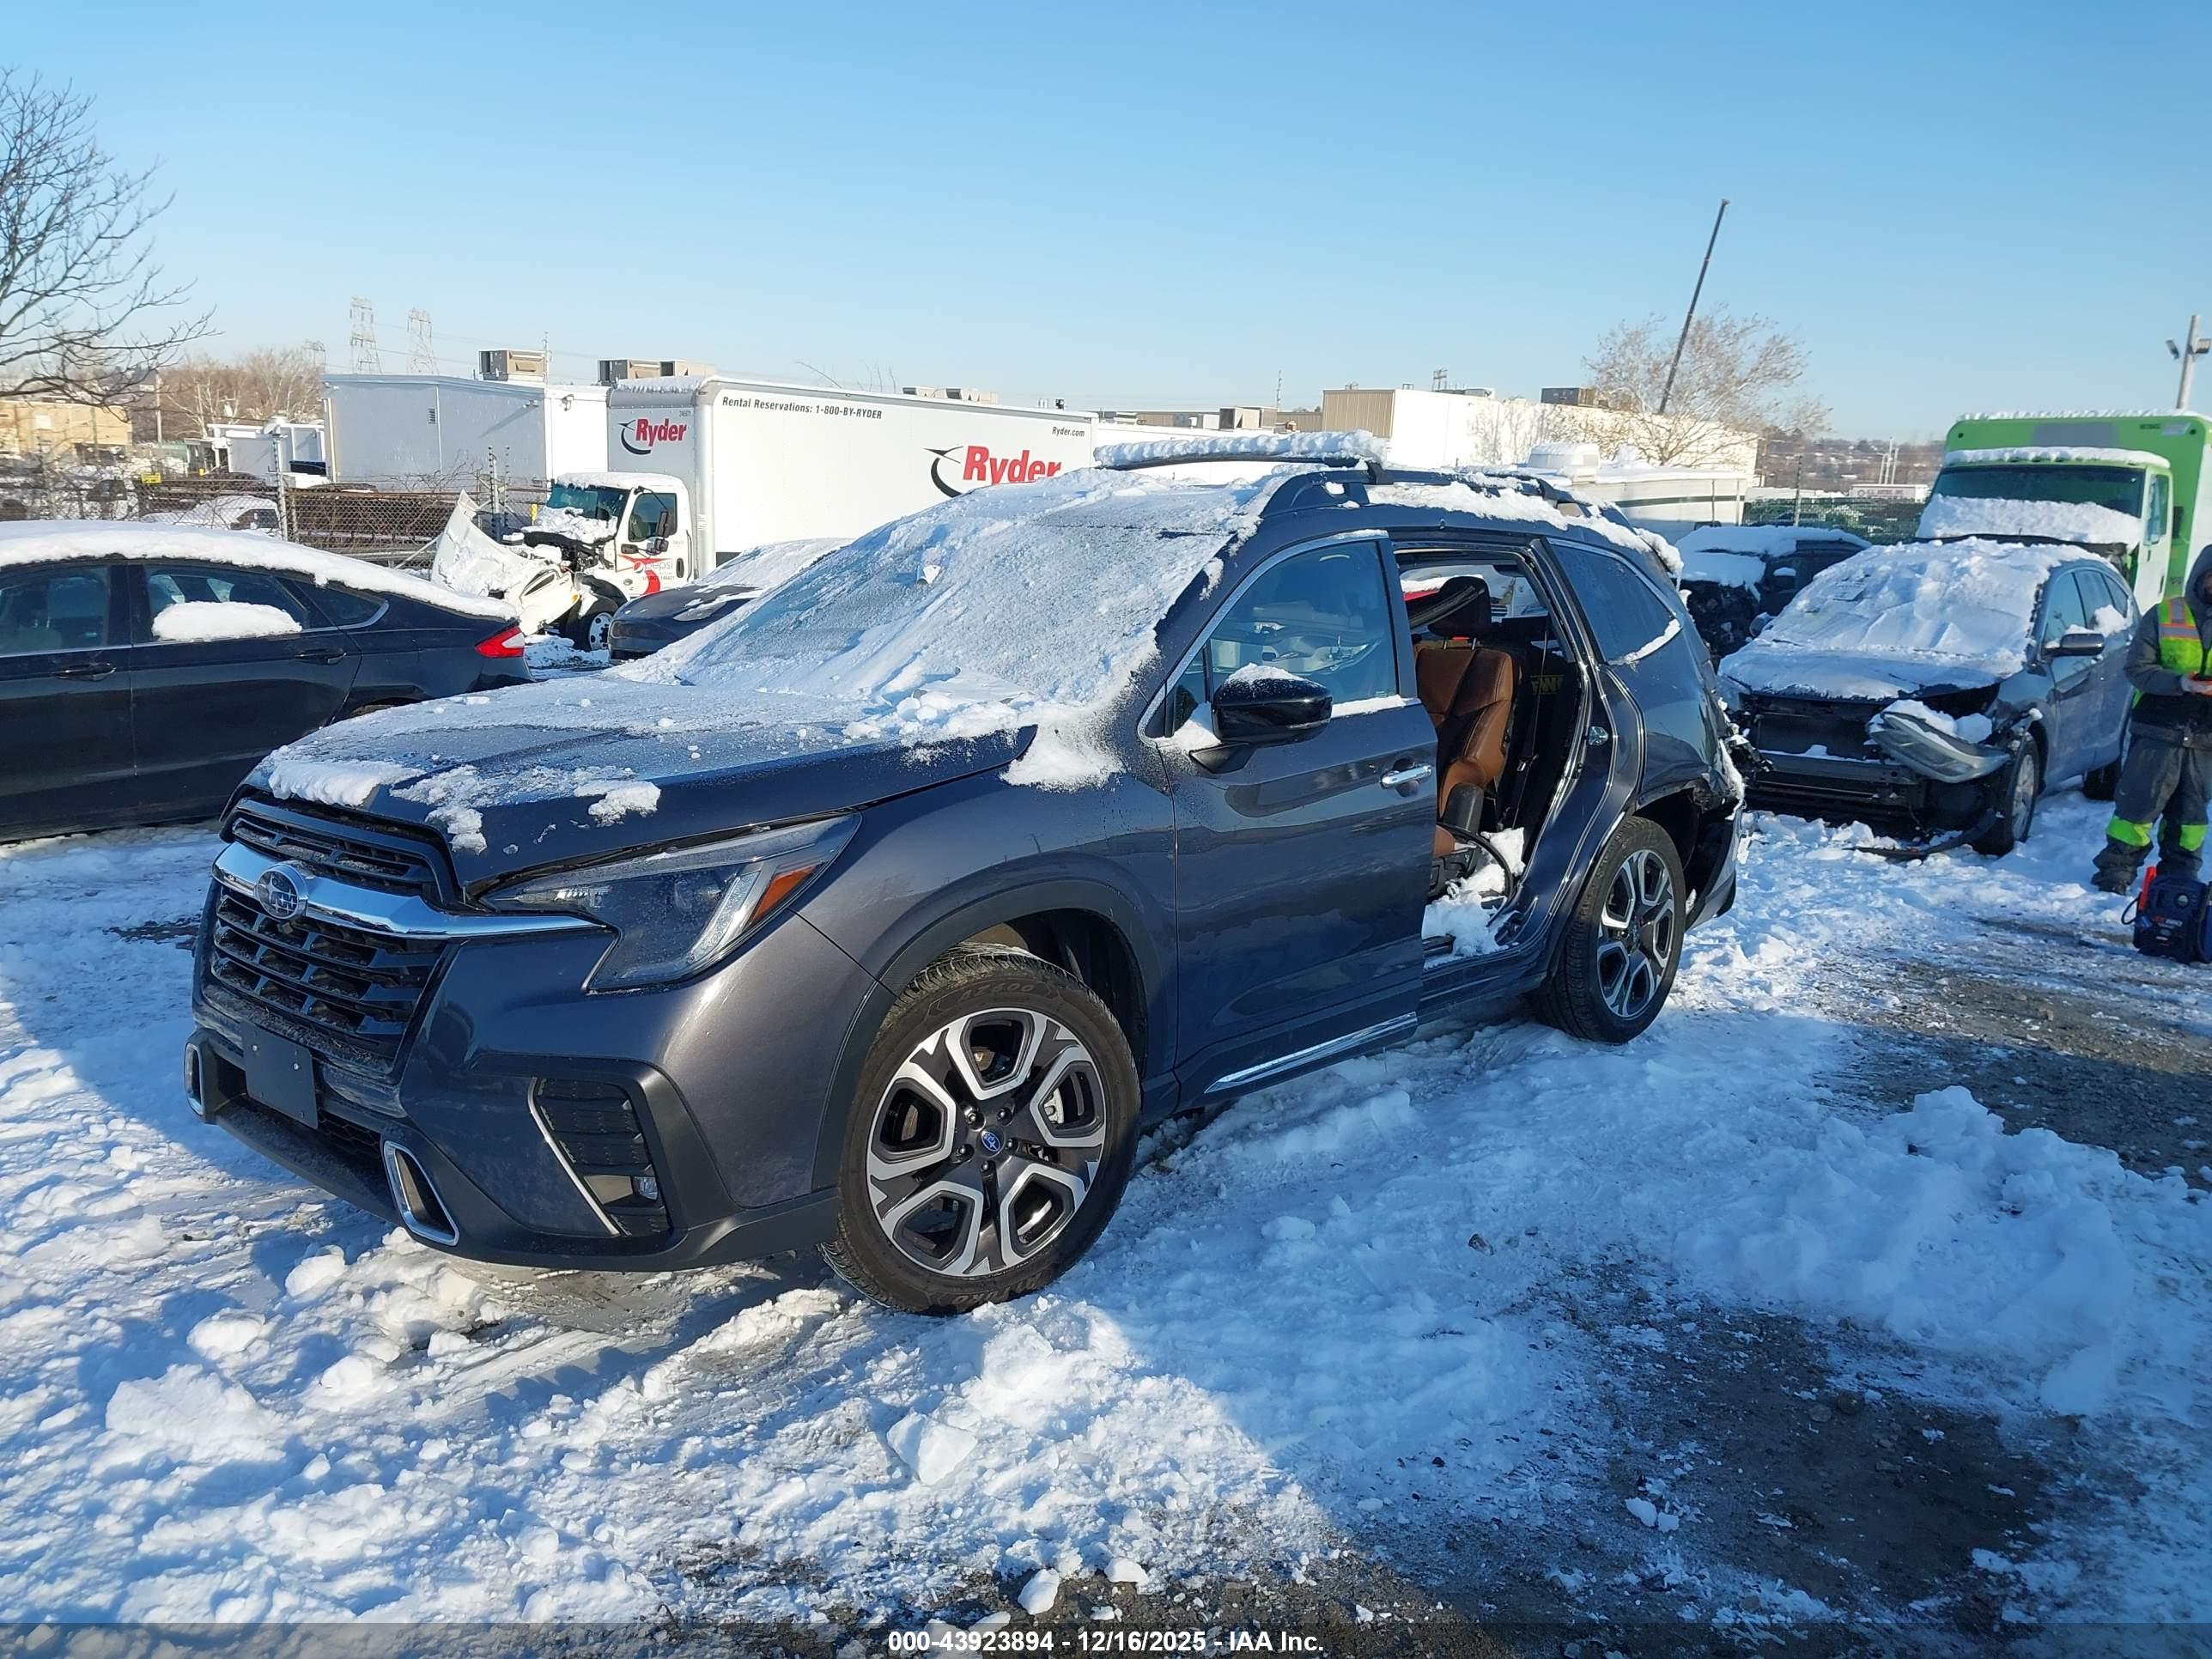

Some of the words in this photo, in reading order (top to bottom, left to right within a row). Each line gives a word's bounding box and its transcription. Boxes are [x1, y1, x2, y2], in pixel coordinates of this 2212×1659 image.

[722, 397, 751, 408] Rental
[754, 399, 813, 413] Reservations:
[815, 404, 882, 419] 1-800-BY-RYDER
[635, 418, 687, 447] Ryder
[1052, 426, 1085, 437] Ryder.com
[963, 446, 1062, 486] Ryder
